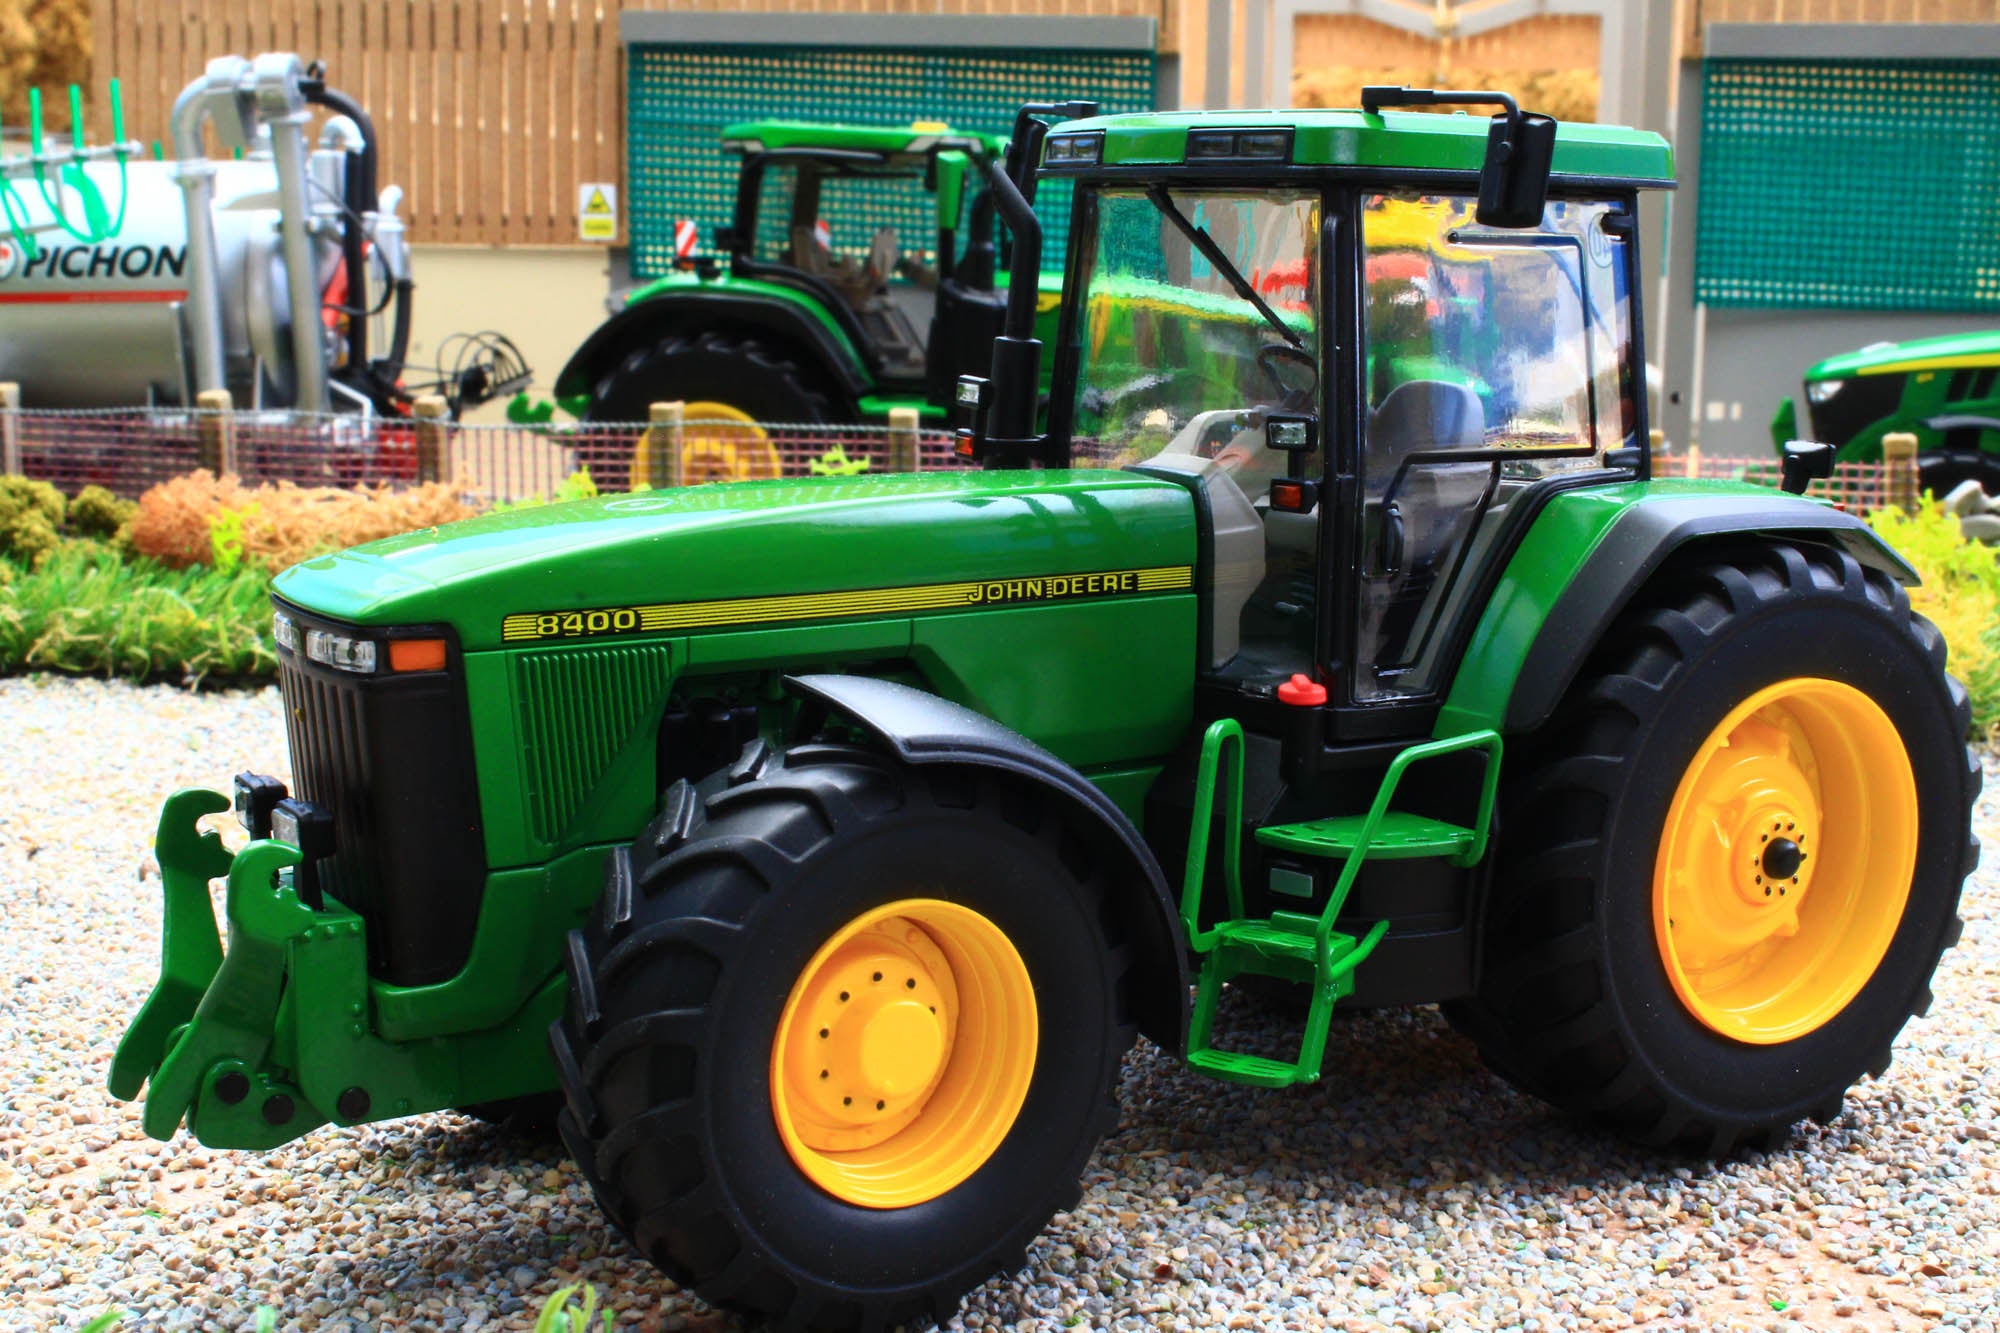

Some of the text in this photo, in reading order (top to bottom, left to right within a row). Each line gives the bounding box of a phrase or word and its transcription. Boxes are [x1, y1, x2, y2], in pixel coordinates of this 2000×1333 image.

[22, 245, 188, 278] PICHON
[968, 573, 1133, 602] JOHN DEERE
[536, 609, 636, 635] 8400
